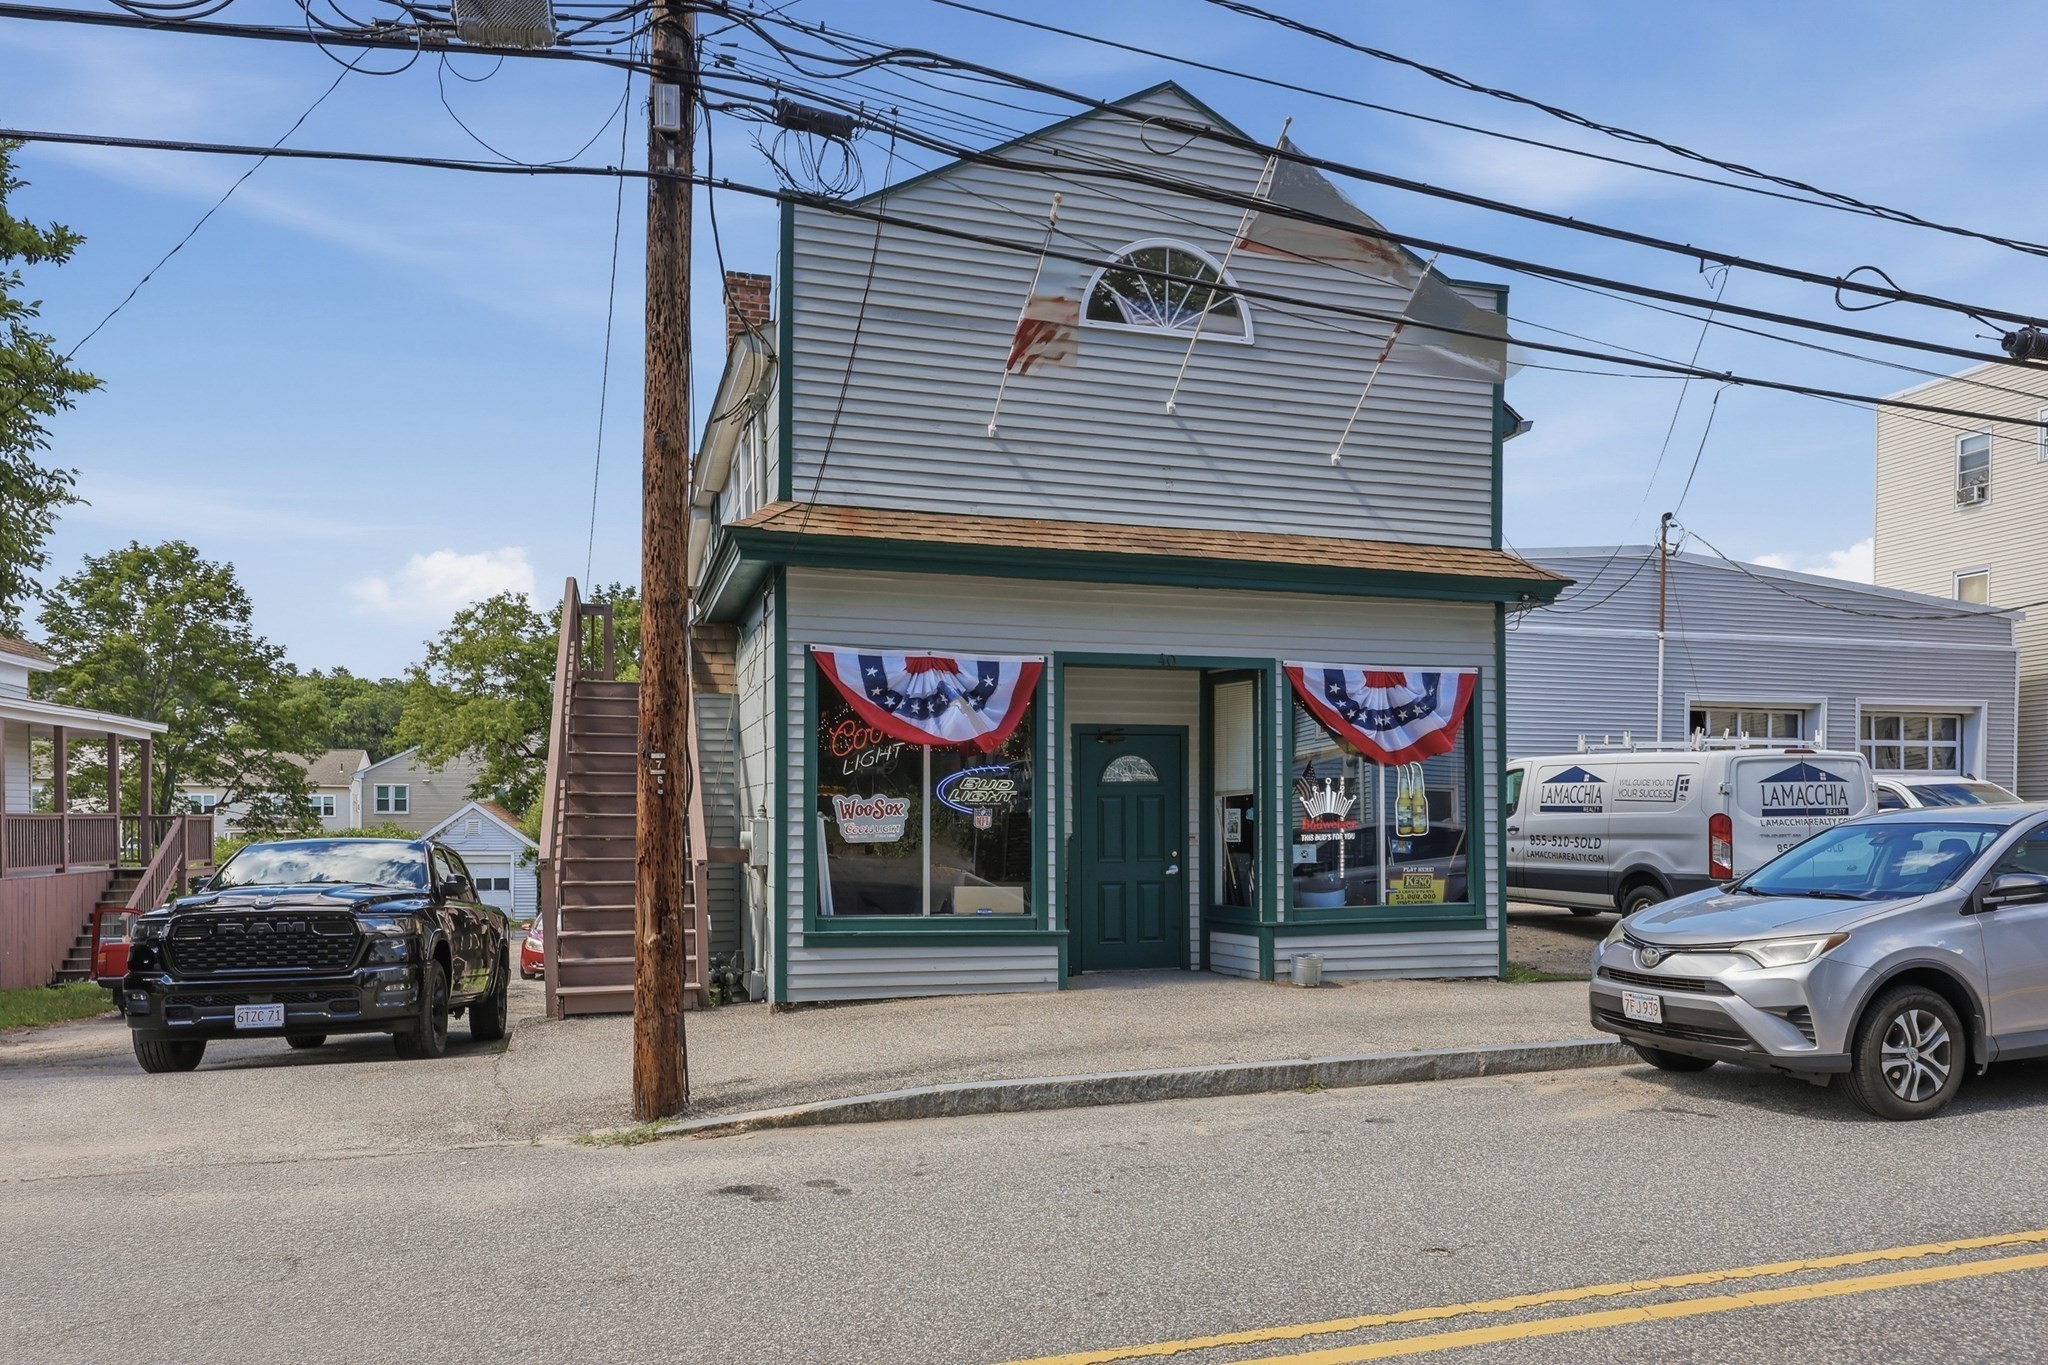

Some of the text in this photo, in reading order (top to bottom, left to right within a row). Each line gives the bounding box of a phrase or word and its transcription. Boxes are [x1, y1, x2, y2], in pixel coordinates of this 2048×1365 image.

[843, 742, 905, 775] LIGHT
[960, 777, 1015, 790] BUD
[1651, 779, 1664, 787] YOU
[948, 788, 1018, 802] LIGHT
[1541, 785, 1602, 804] LAMACCHIA
[1617, 788, 1673, 798] YOUR SUCCESS
[1761, 784, 1848, 806] LAMACCHIA
[837, 799, 905, 820] WooSox
[1332, 832, 1343, 840] FOR
[1344, 832, 1356, 840] YOU
[1529, 834, 1602, 849] 855-510-SOLD
[1526, 850, 1605, 863] LAMACCHIAREALTY.COM
[217, 921, 306, 934] RAM
[237, 1010, 282, 1023] 6TZC 71
